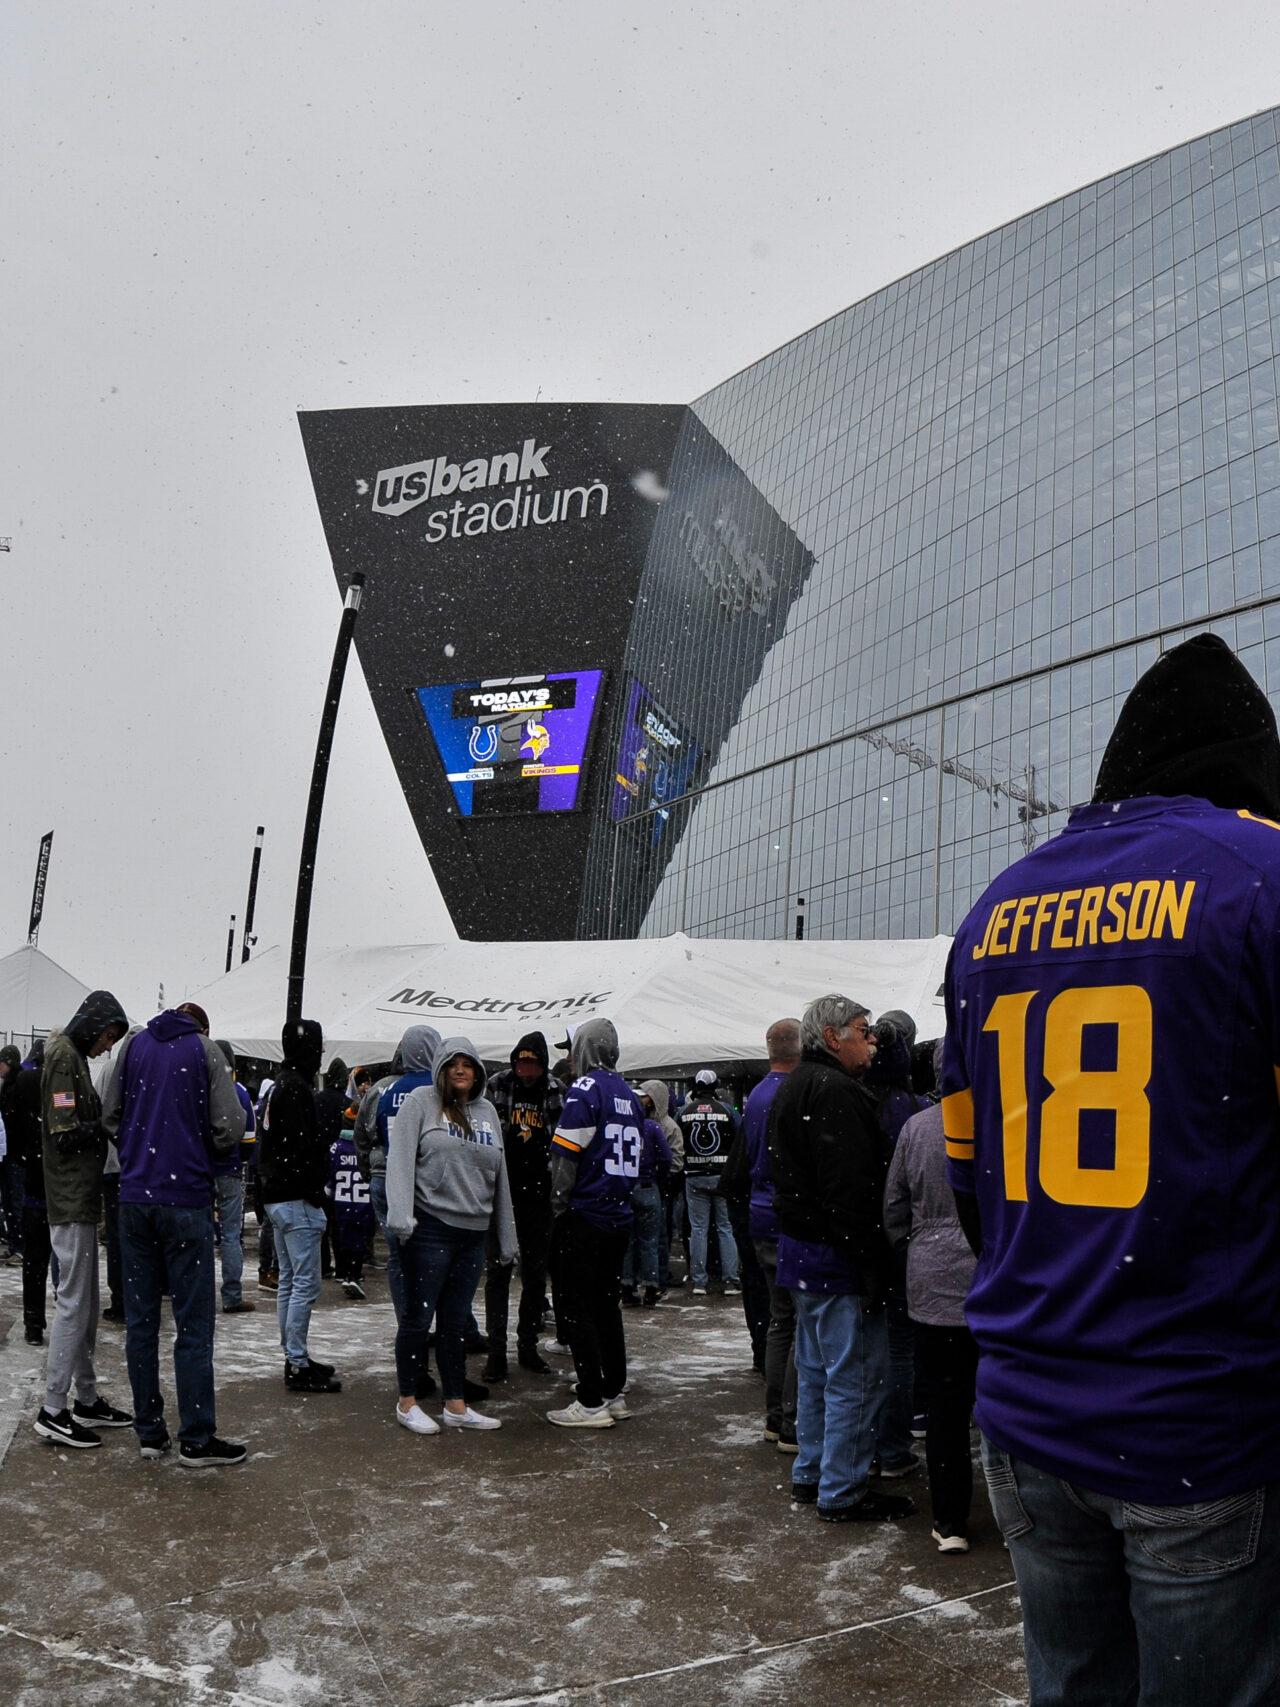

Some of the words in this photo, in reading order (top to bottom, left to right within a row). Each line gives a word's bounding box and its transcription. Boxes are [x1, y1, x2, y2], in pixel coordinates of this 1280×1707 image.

[425, 483, 609, 543] stadium
[469, 688, 550, 707] TODAY'S
[972, 879, 1196, 960] JEFFERSON
[388, 988, 613, 1013] Medtronic
[982, 985, 1152, 1208] 18
[681, 1113, 705, 1122] SUPER
[707, 1113, 729, 1121] BOWL
[340, 1155, 358, 1166] SMIT
[604, 1123, 641, 1178] 33
[687, 1155, 728, 1163] CHAMPIONS
[335, 1170, 370, 1202] 22
